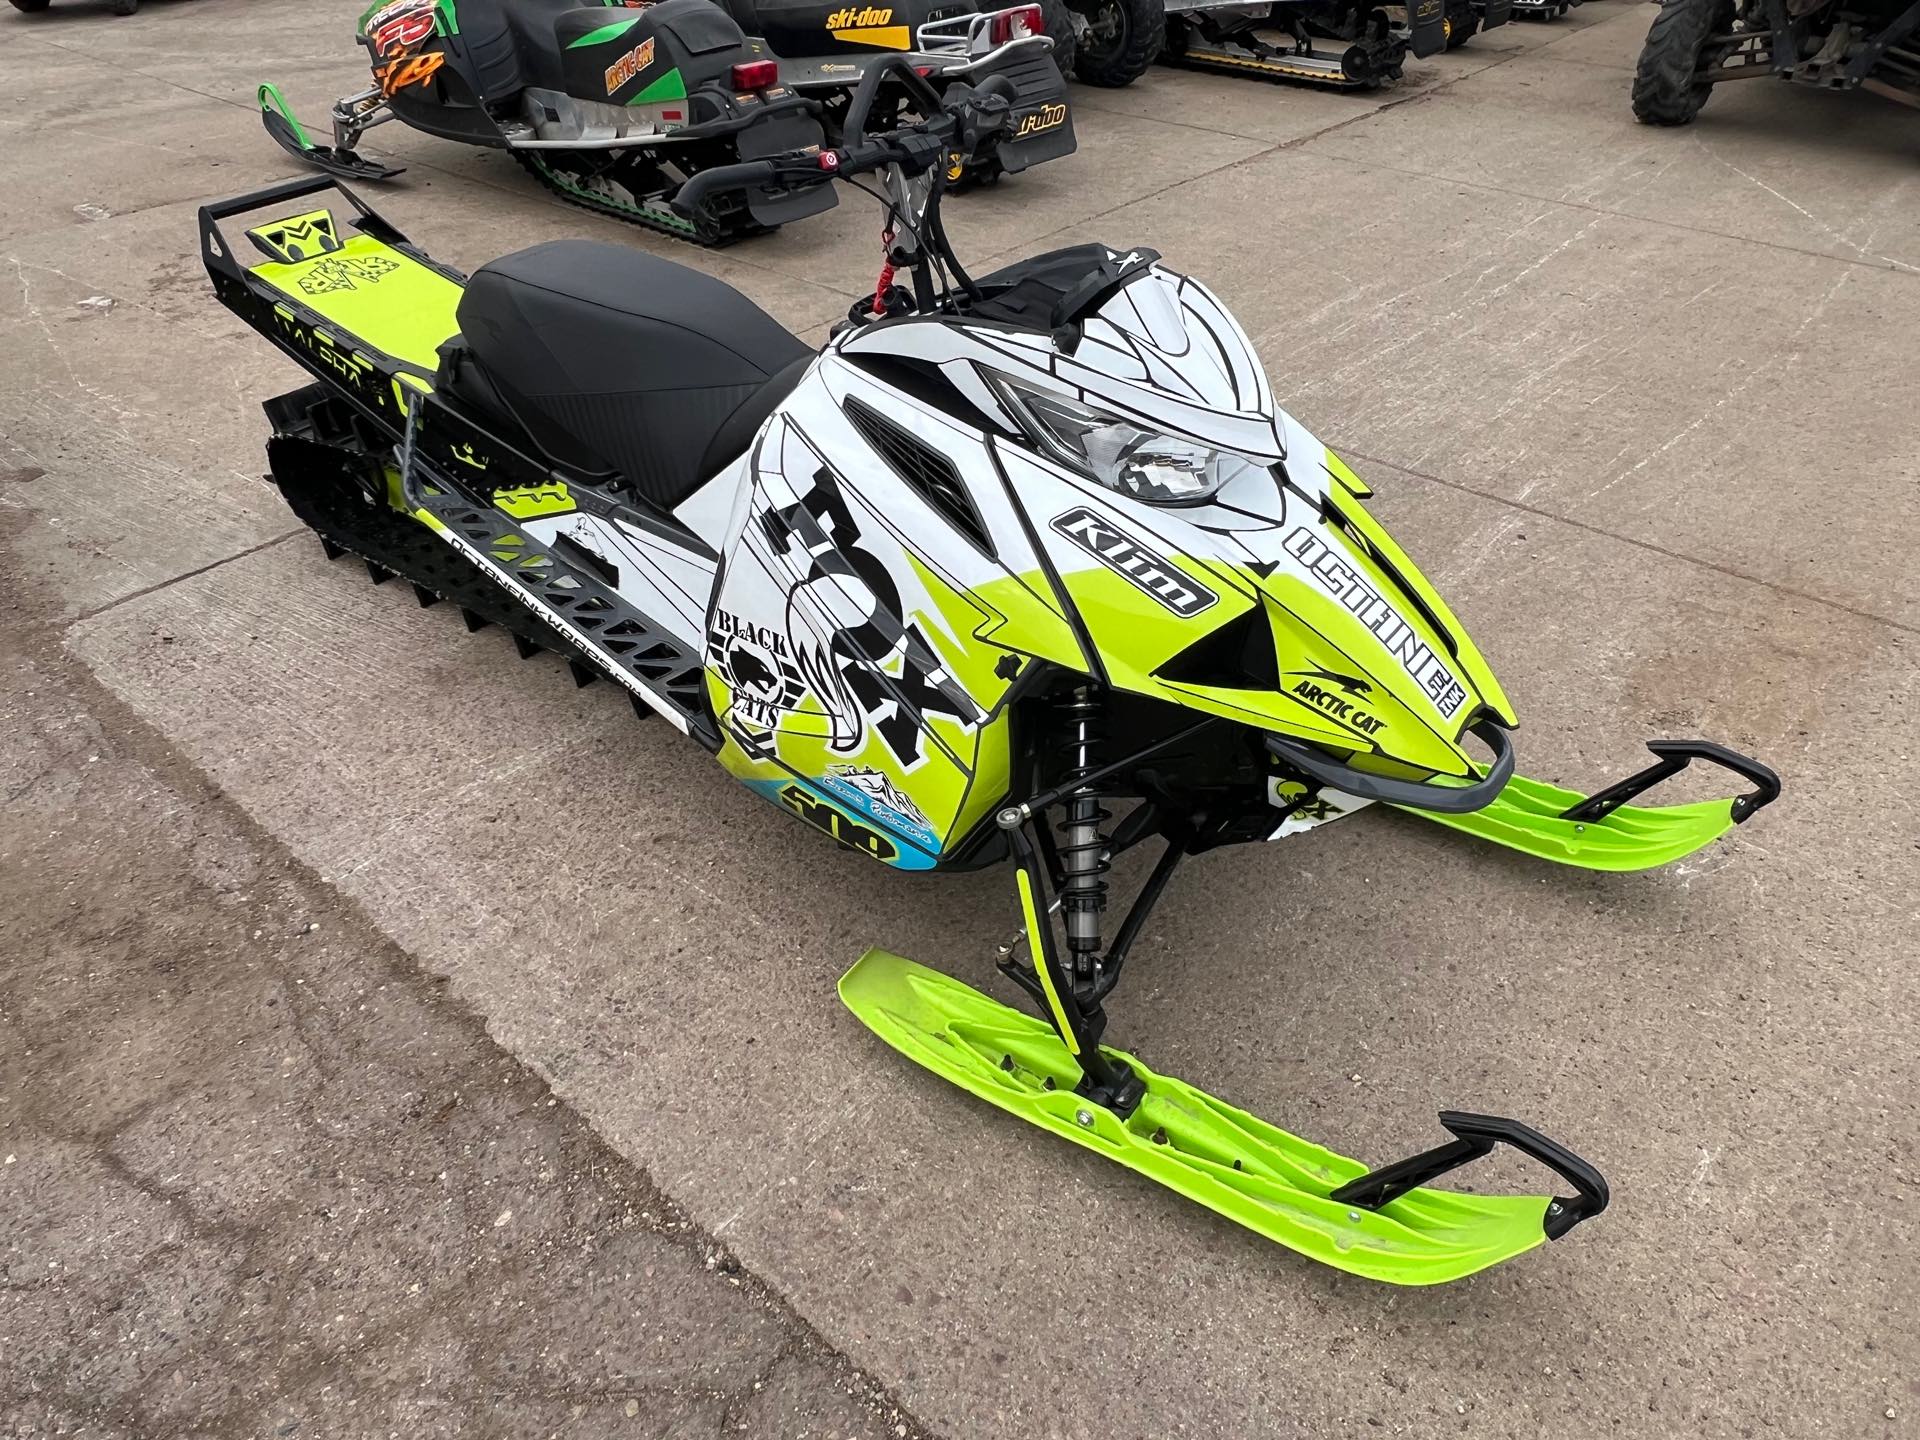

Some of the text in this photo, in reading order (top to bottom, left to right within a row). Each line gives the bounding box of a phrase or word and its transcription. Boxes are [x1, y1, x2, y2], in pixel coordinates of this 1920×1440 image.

[716, 607, 789, 660] BLACK
[758, 462, 980, 768] FOX
[1281, 526, 1454, 702] OCTANE
[1437, 682, 1468, 720] INK
[732, 686, 780, 729] CATS
[1291, 680, 1386, 735] ARCTIC CAT
